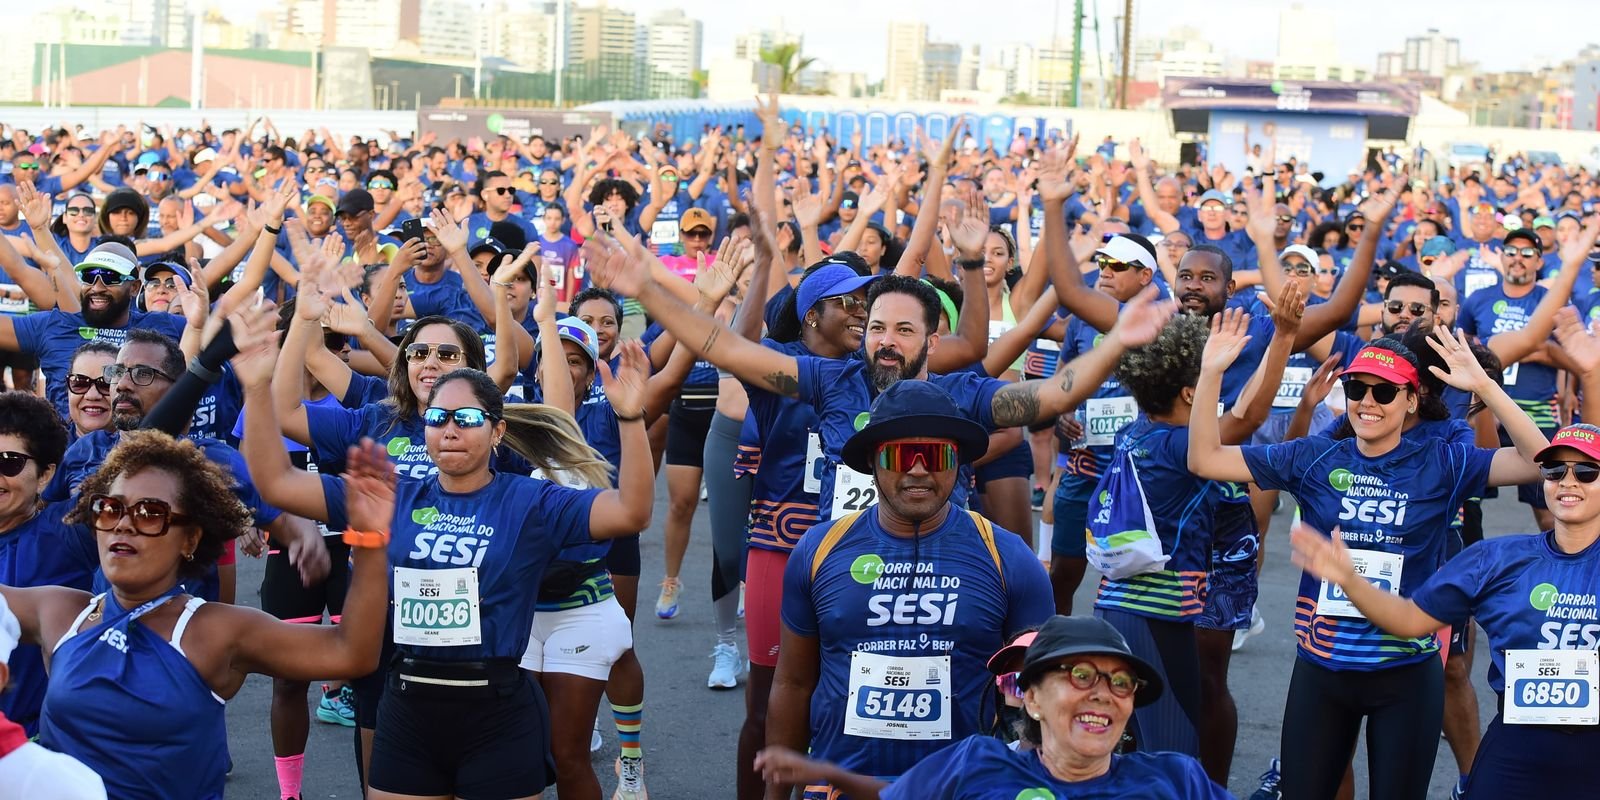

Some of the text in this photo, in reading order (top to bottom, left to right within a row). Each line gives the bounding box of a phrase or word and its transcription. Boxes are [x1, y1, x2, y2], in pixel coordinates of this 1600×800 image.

[1376, 353, 1394, 364] days
[1277, 383, 1304, 397] 077
[205, 395, 215, 405] DO
[1573, 430, 1594, 440] days
[403, 444, 428, 453] CORR
[397, 454, 434, 463] NACION
[431, 513, 477, 526] CORRIDA
[423, 522, 494, 537] NACIONAL DO
[1360, 533, 1373, 543] FAZ
[1385, 536, 1403, 544] BEM
[940, 576, 960, 589] DO
[1551, 592, 1596, 606] CORRIDA
[401, 601, 469, 626] 10036
[1546, 605, 1598, 620] NACIONAL
[857, 640, 897, 652] CORRER
[898, 640, 917, 650] FAZ
[932, 641, 955, 651] BEM
[1522, 681, 1580, 705] 6850
[864, 690, 932, 718] 5148
